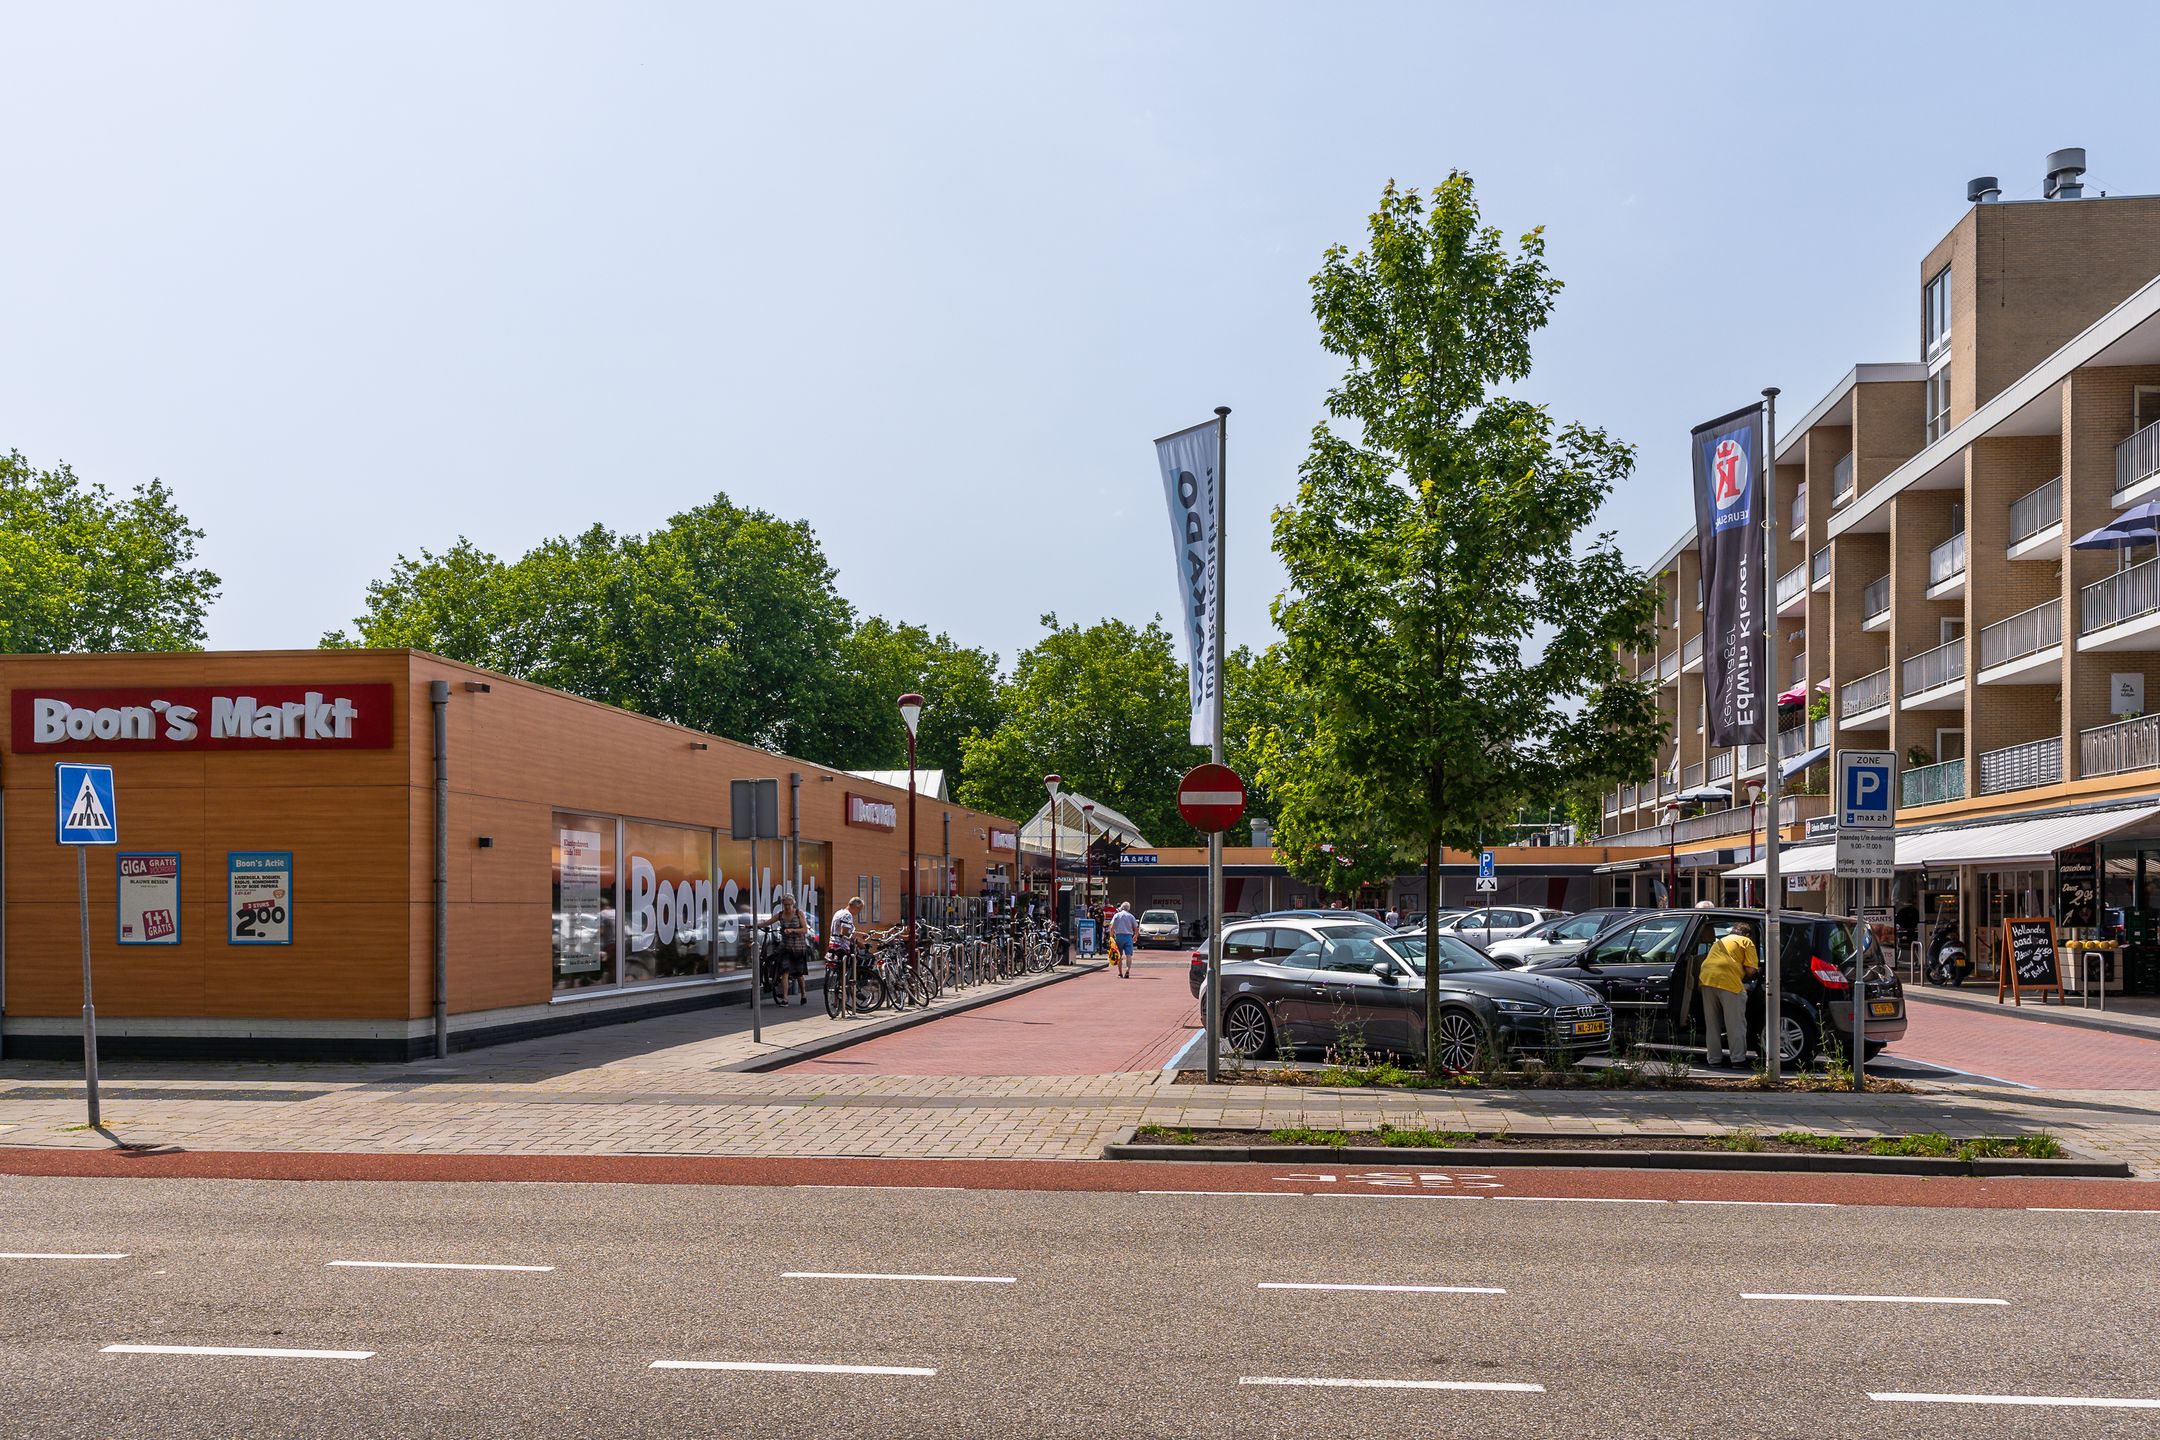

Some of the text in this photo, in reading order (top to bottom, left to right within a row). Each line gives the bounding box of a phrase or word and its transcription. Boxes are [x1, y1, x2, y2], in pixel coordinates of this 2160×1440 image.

[34, 691, 358, 743] Boon's Markt
[1856, 771, 1880, 805] P
[1871, 835, 1893, 843] donderdag
[121, 859, 176, 874] GIGA GRATIS
[235, 859, 285, 867] Boon's Actie
[1483, 854, 1490, 866] P
[632, 856, 739, 952] Boon's
[146, 910, 170, 926] 1+1
[148, 923, 172, 936] GRATIS
[2012, 925, 2045, 937] Hollandse
